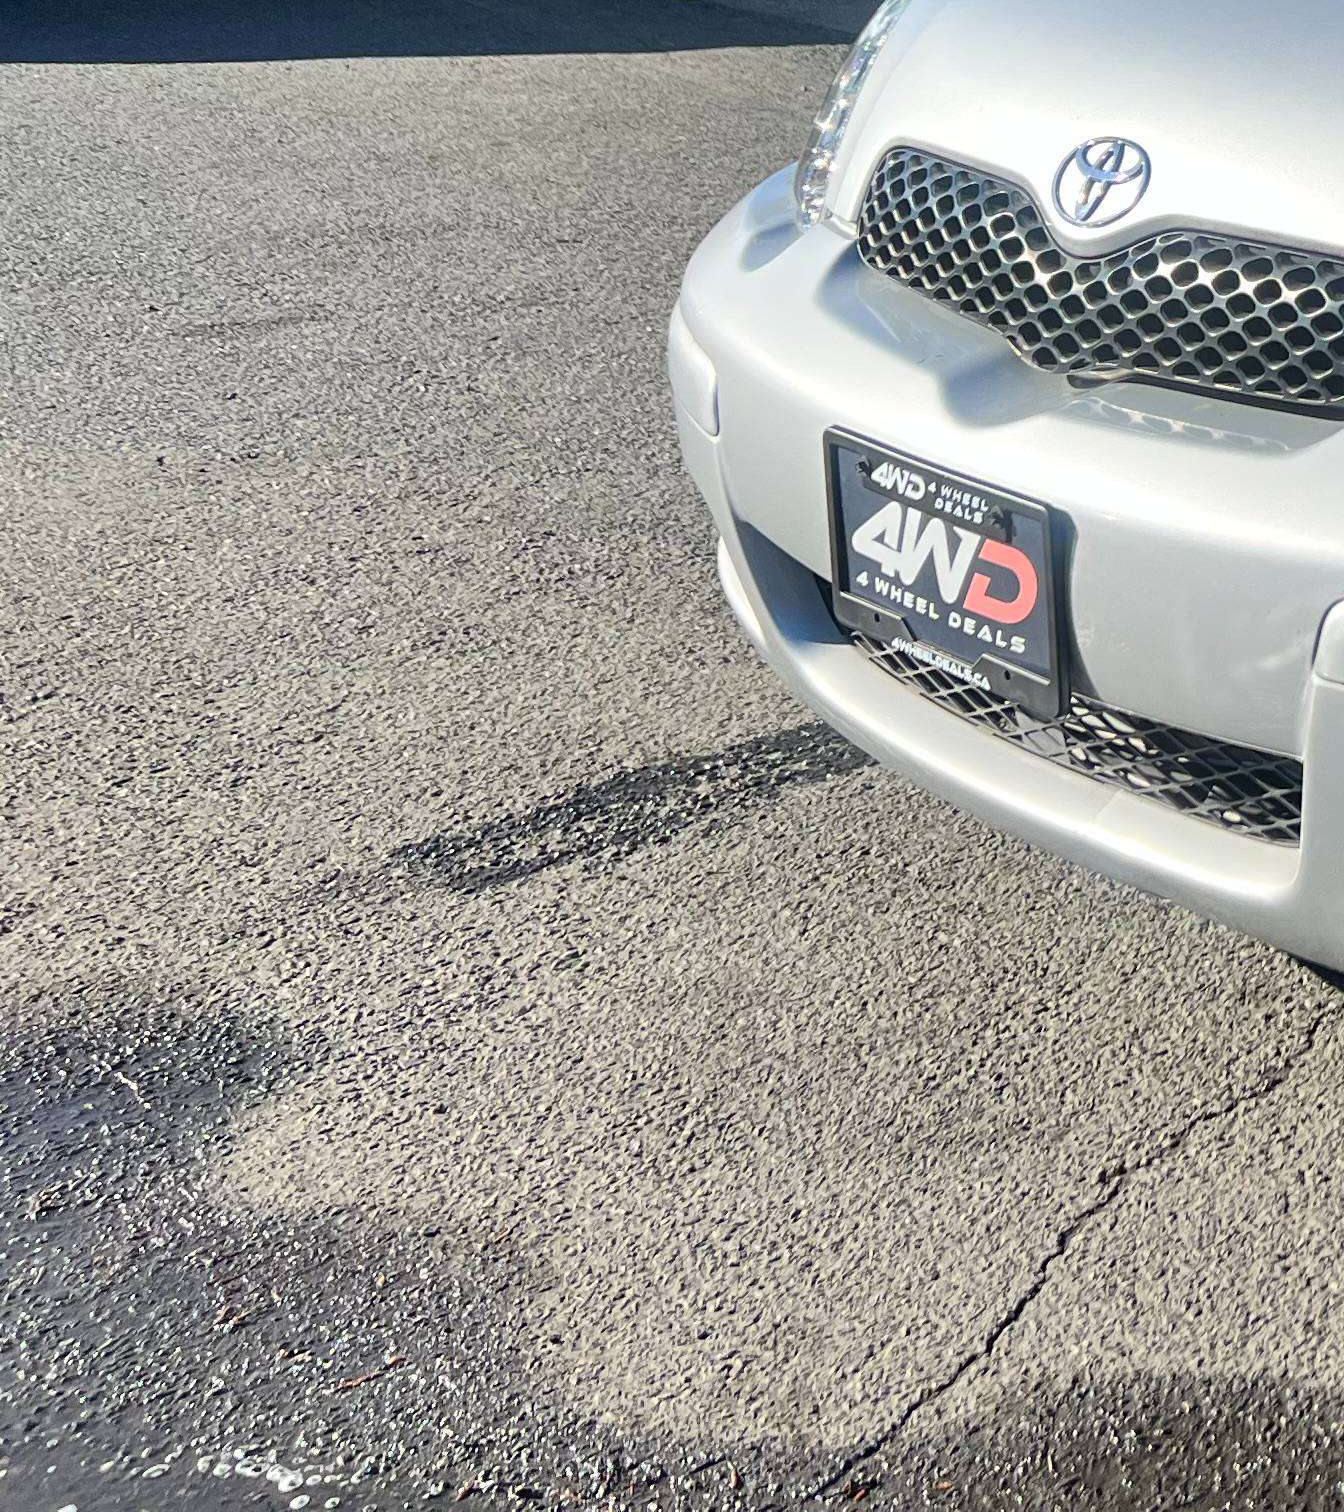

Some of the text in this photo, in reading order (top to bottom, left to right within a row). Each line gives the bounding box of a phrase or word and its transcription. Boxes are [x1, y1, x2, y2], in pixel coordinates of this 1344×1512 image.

[870, 461, 990, 512] 4WD 4 WHEEL
[934, 497, 984, 524] DEALS
[851, 501, 1039, 624] 4WD
[856, 571, 1027, 655] 4 WHEEL DEALS
